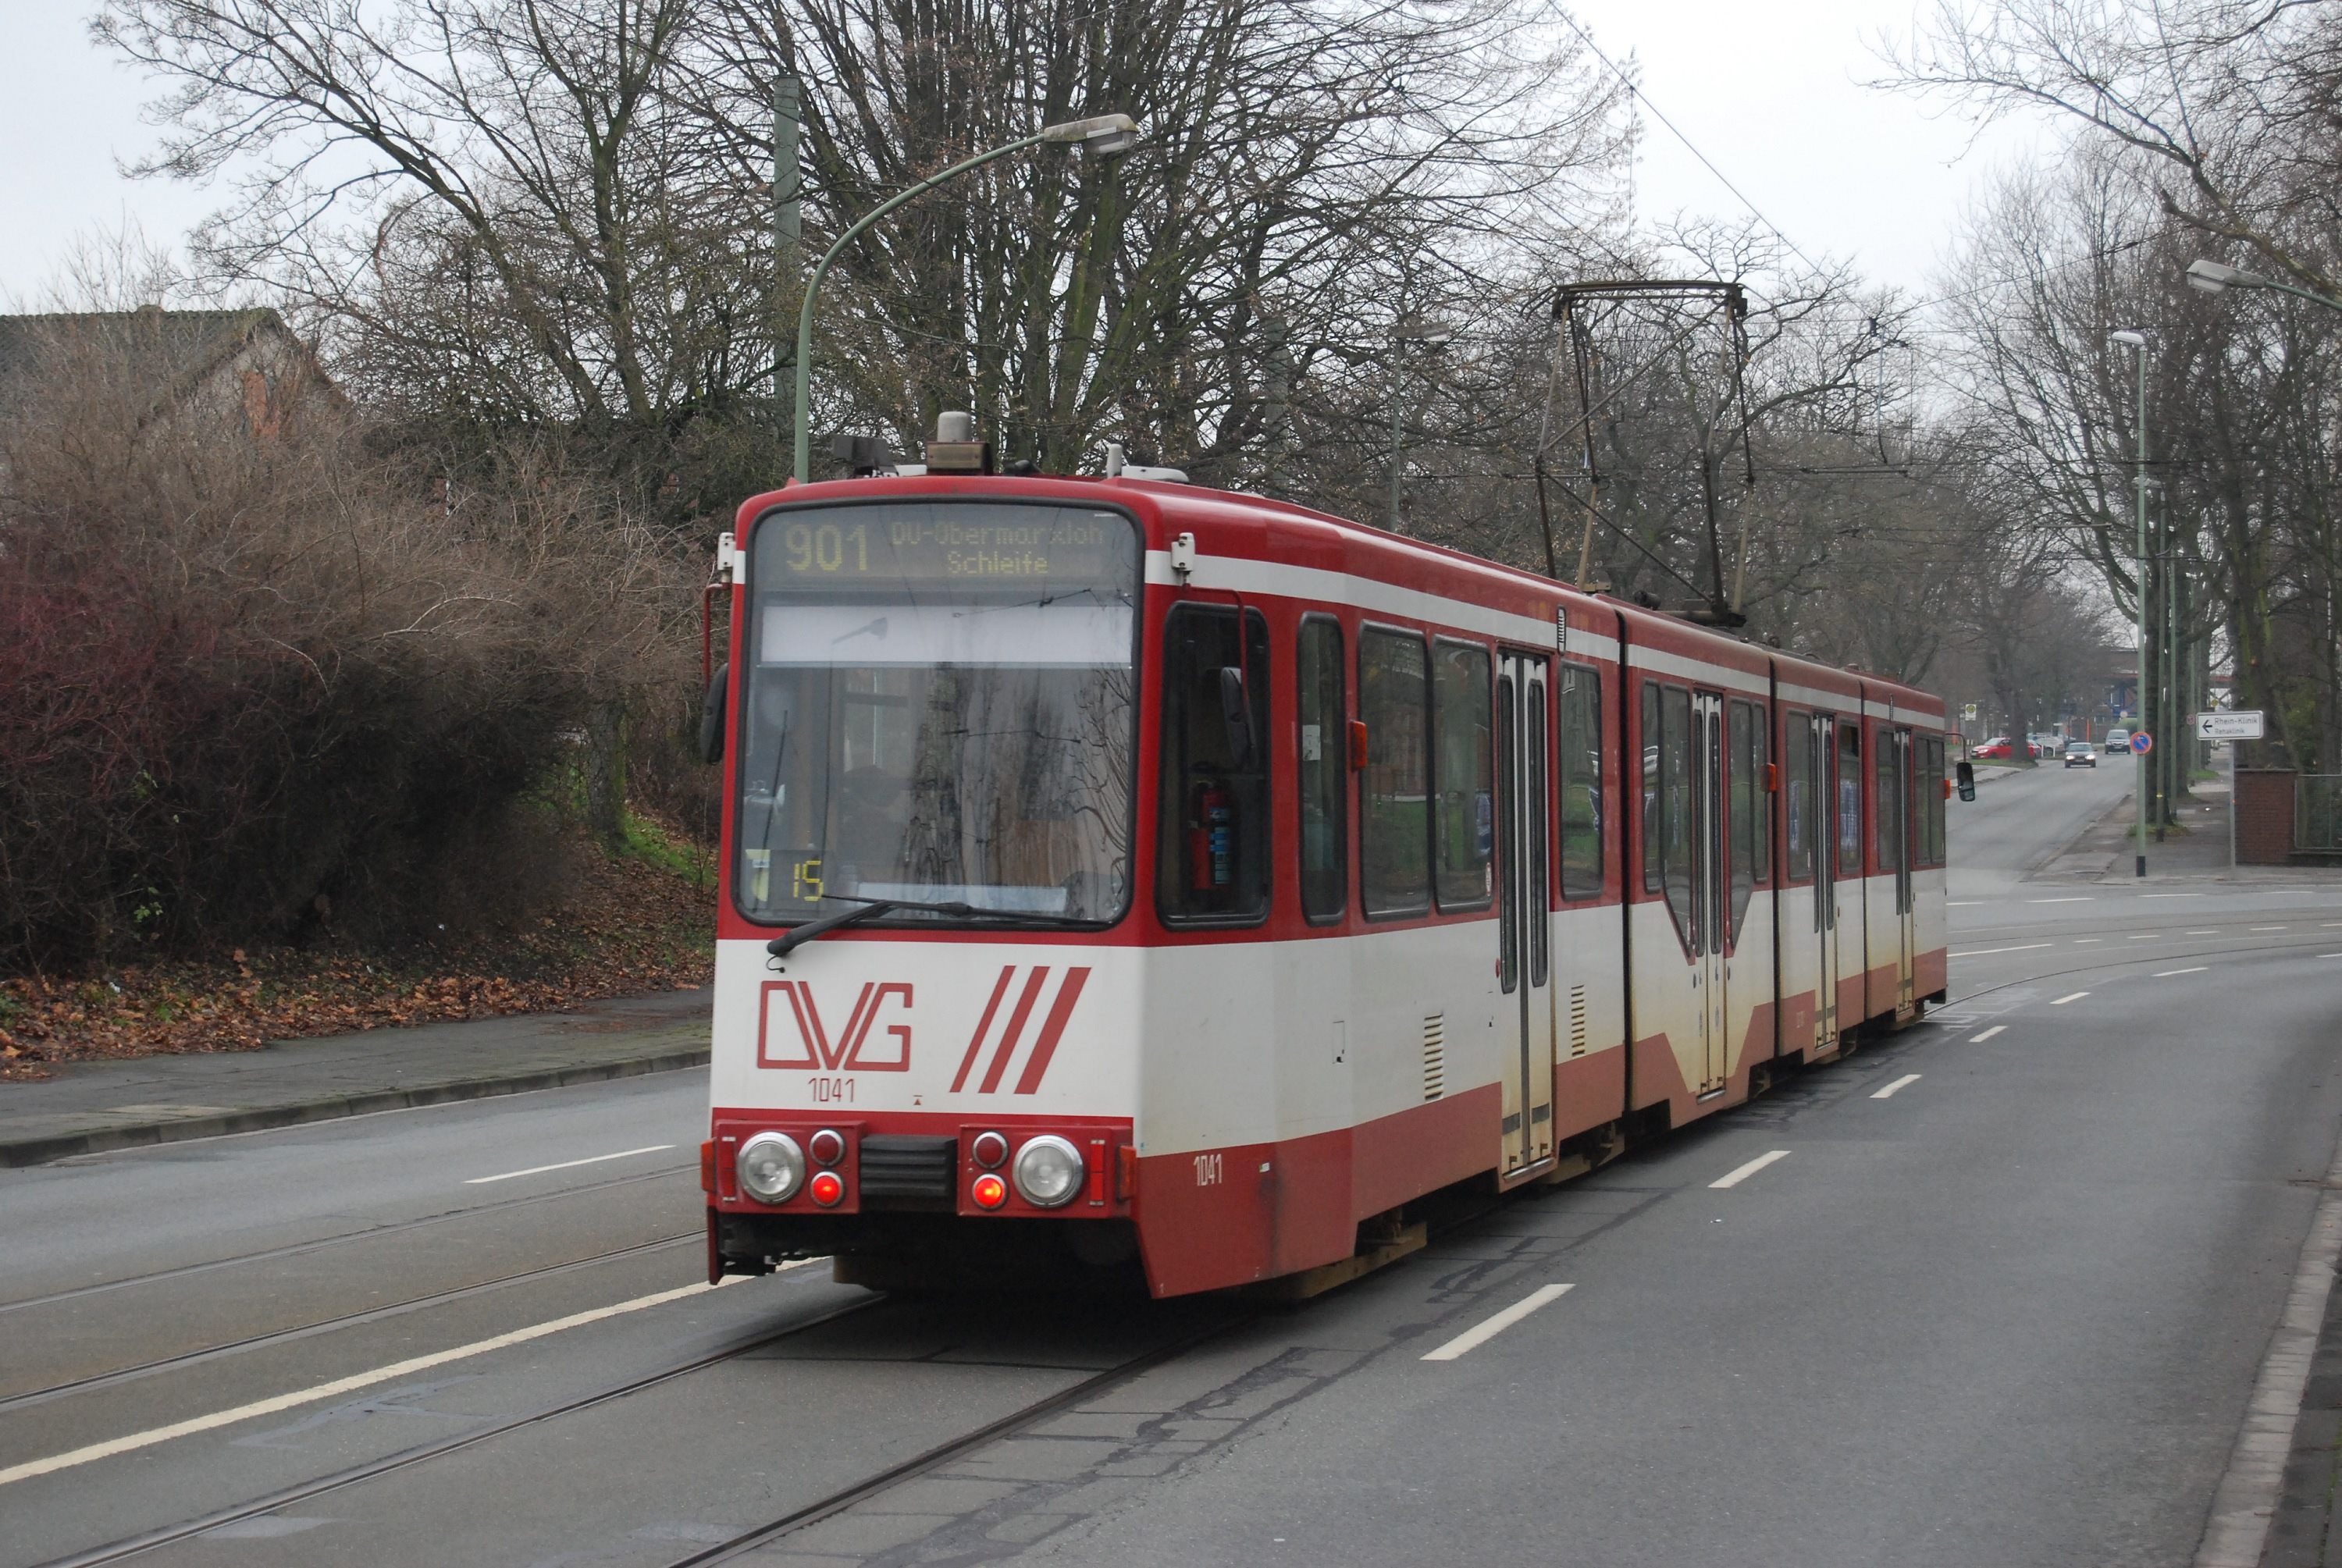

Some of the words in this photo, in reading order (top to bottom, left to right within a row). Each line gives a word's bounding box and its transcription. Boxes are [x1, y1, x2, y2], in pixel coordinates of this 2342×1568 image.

[786, 524, 868, 571] 901
[947, 550, 1049, 574] Schleife
[757, 980, 913, 1072] DVG
[807, 1077, 855, 1103] 1041
[1192, 1153, 1223, 1187] 1041
